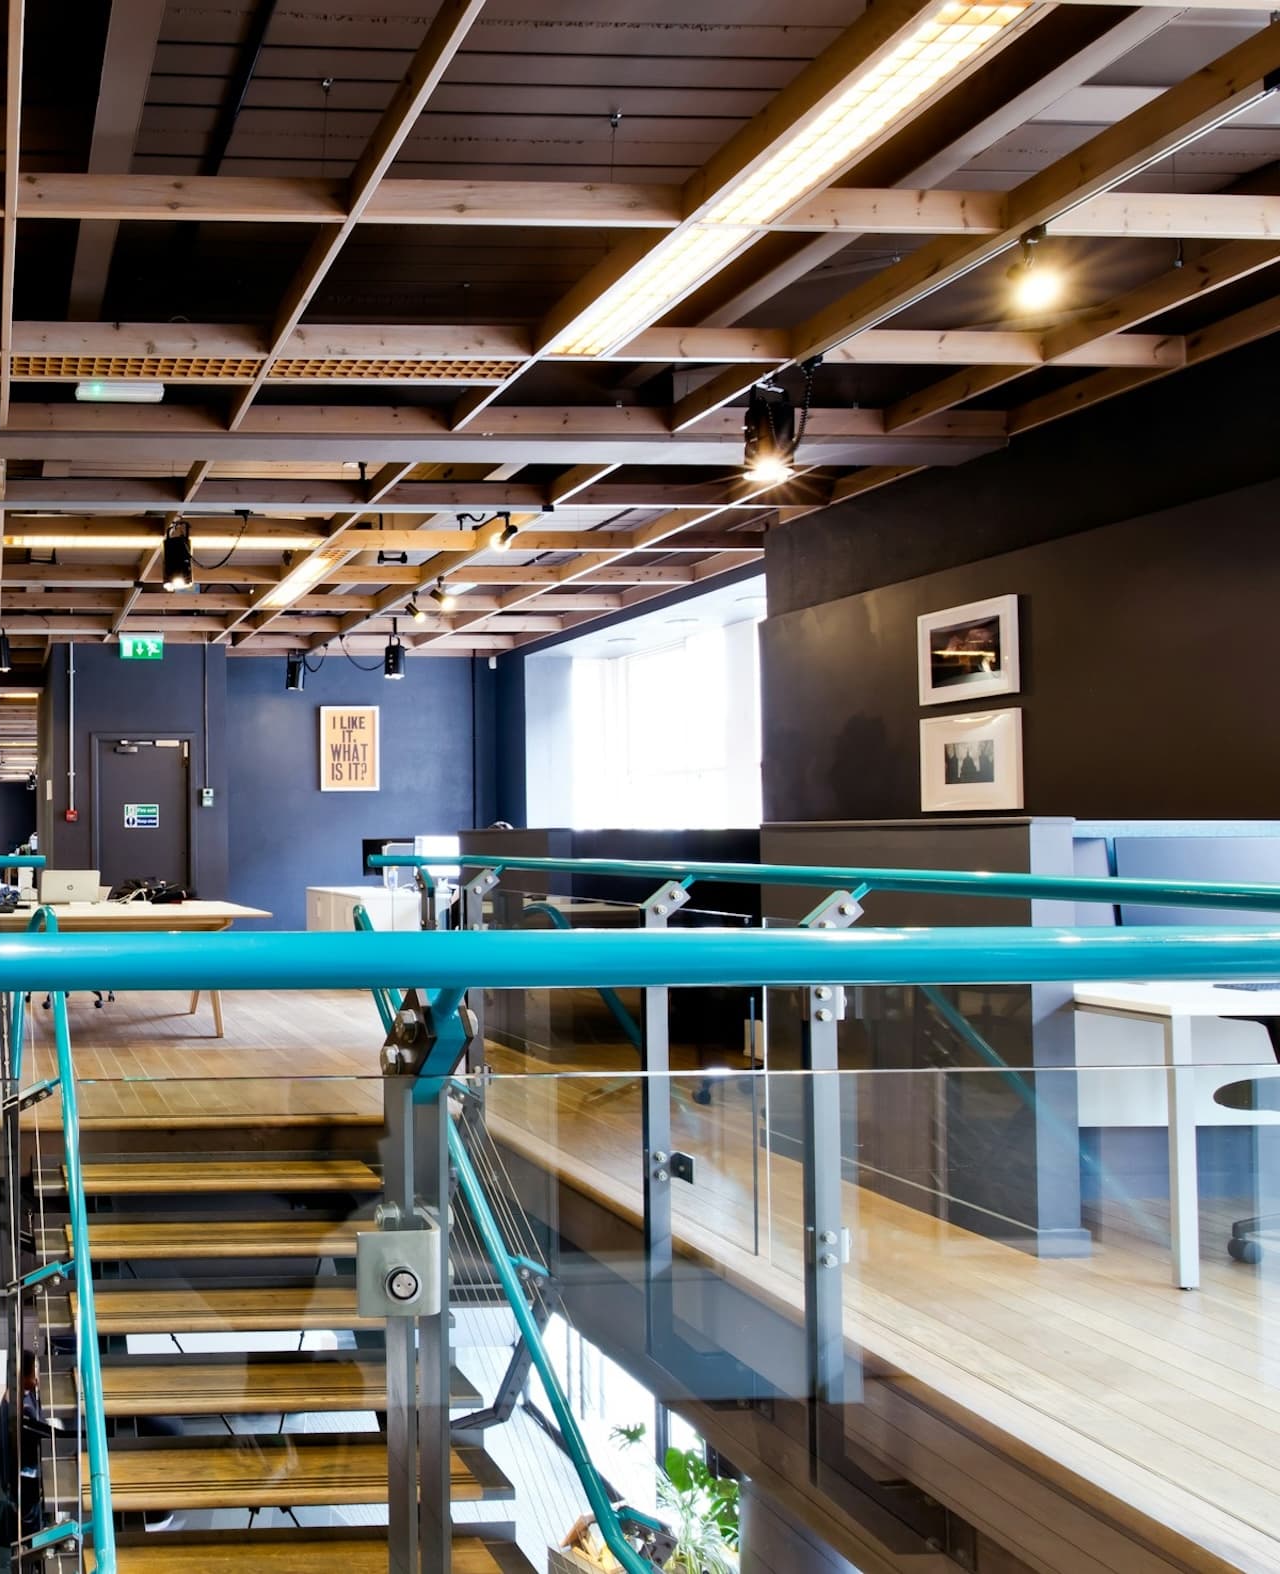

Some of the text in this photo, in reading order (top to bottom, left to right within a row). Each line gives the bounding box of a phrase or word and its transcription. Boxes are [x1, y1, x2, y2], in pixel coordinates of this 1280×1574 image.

[332, 716, 366, 729] I LIKE
[342, 730, 357, 743] IT.
[330, 743, 368, 762] WHAT
[331, 762, 368, 781] IS IT?
